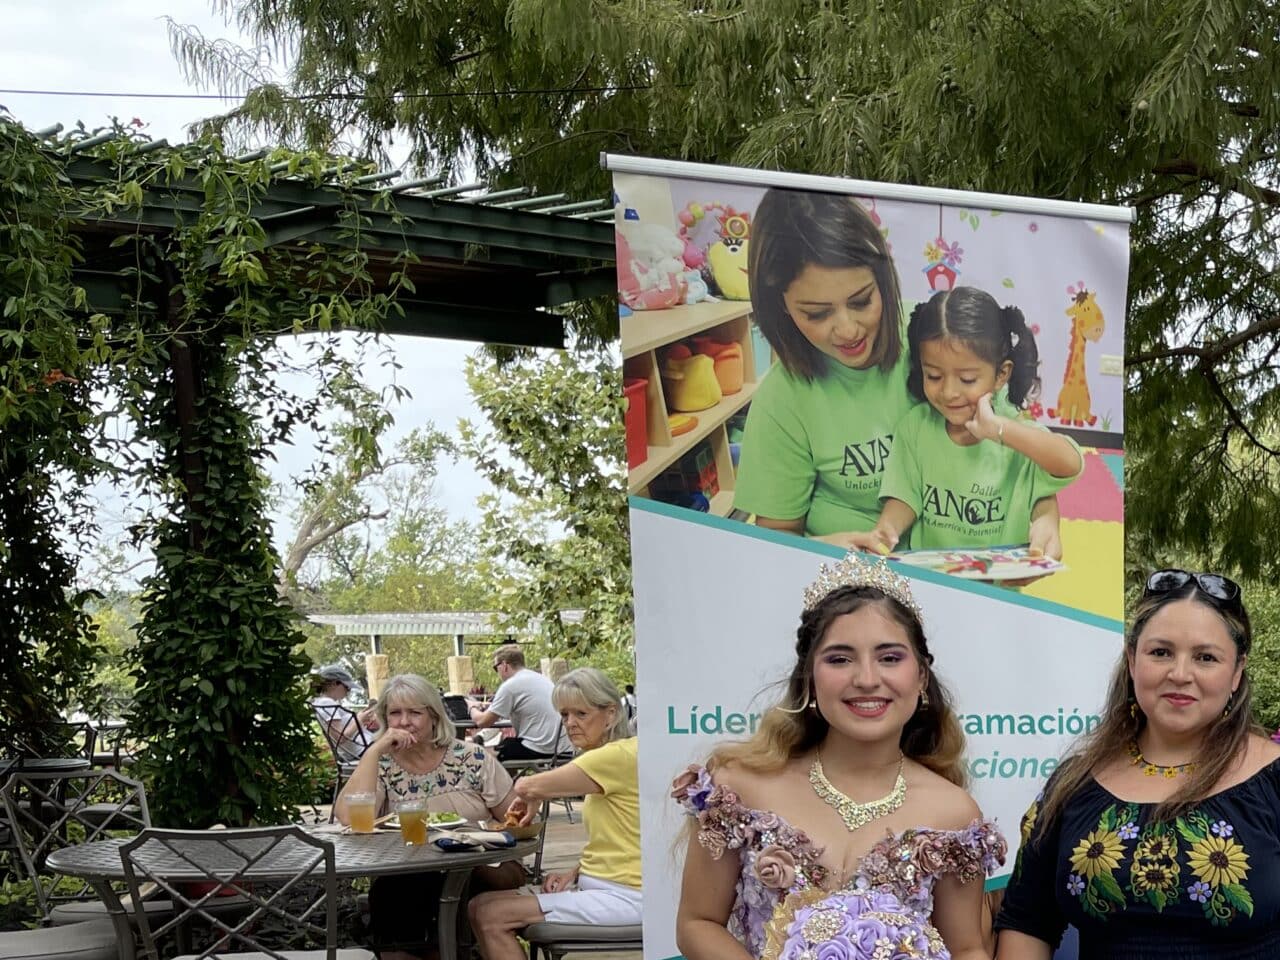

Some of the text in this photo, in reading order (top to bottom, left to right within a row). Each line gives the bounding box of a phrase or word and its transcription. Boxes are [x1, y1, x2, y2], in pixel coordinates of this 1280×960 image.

[839, 434, 894, 477] AVA
[970, 483, 1001, 496] Dalla
[667, 704, 1101, 735] Líder amación
[970, 751, 1059, 779] cione
